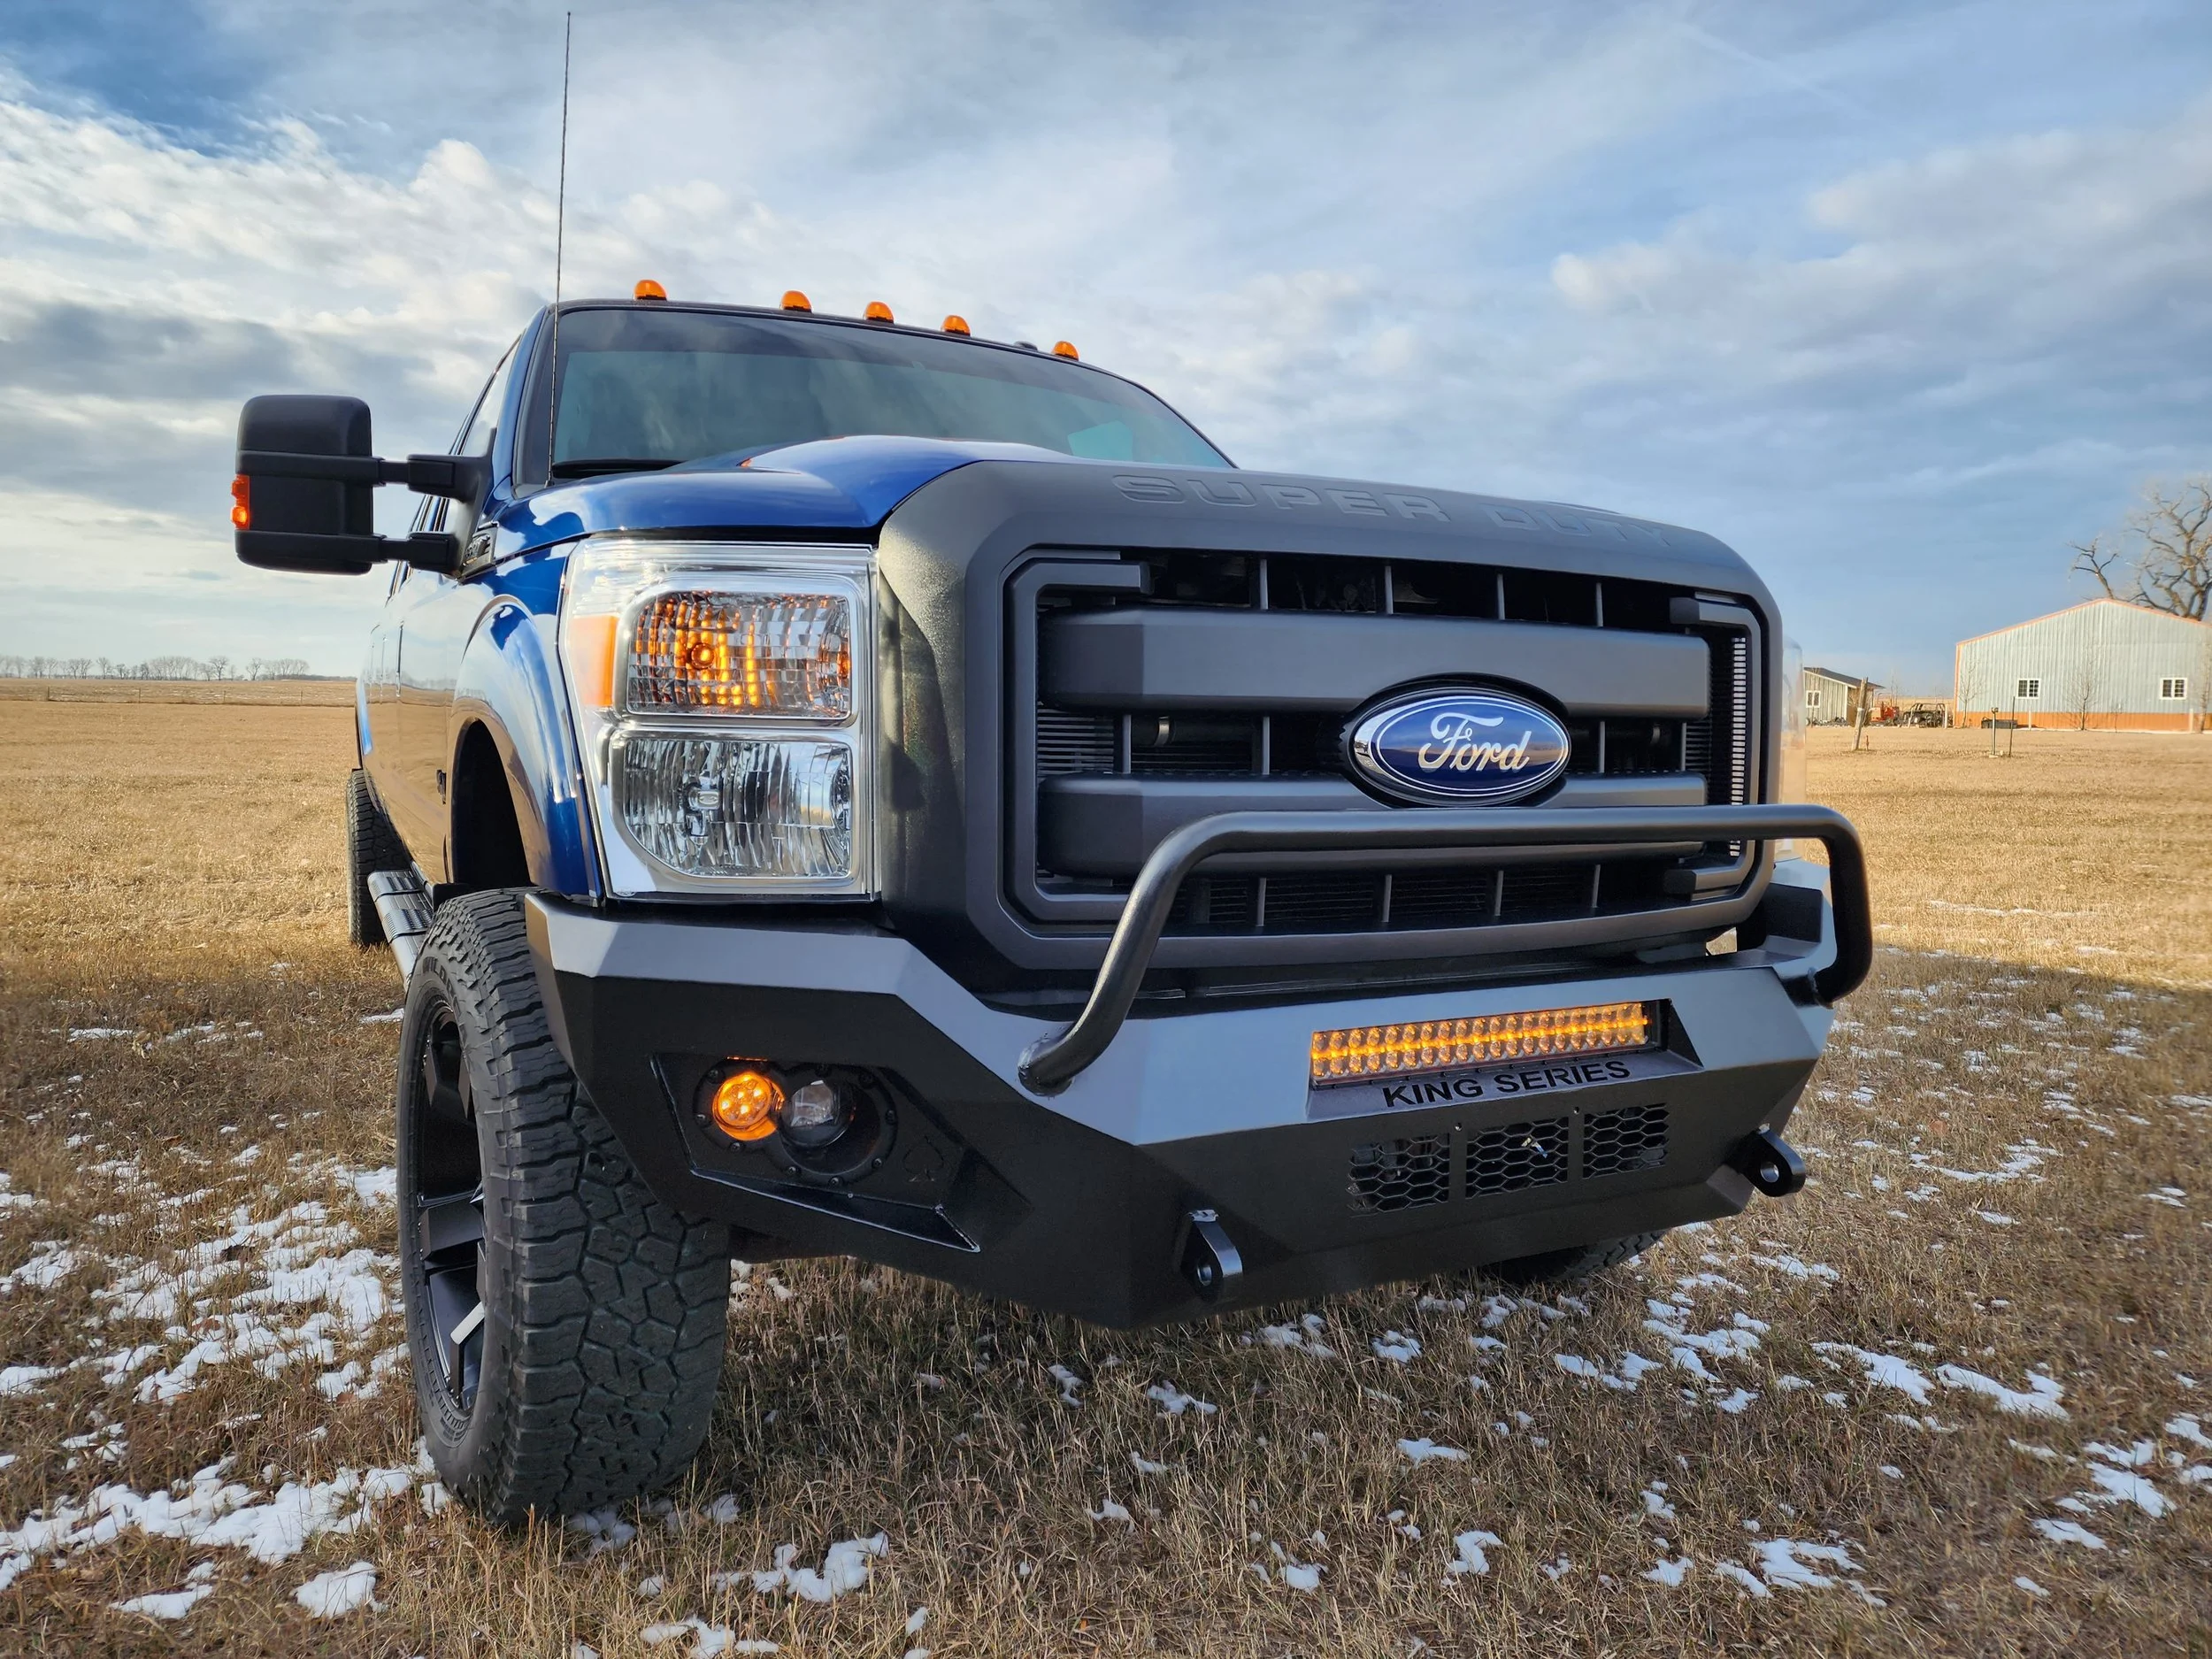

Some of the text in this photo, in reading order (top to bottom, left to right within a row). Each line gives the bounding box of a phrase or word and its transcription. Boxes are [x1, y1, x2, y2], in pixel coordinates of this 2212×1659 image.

[1111, 474, 1671, 547] SUPER DUTY
[1417, 711, 1532, 772] Ford
[1382, 1061, 1631, 1108] KING SERIES
